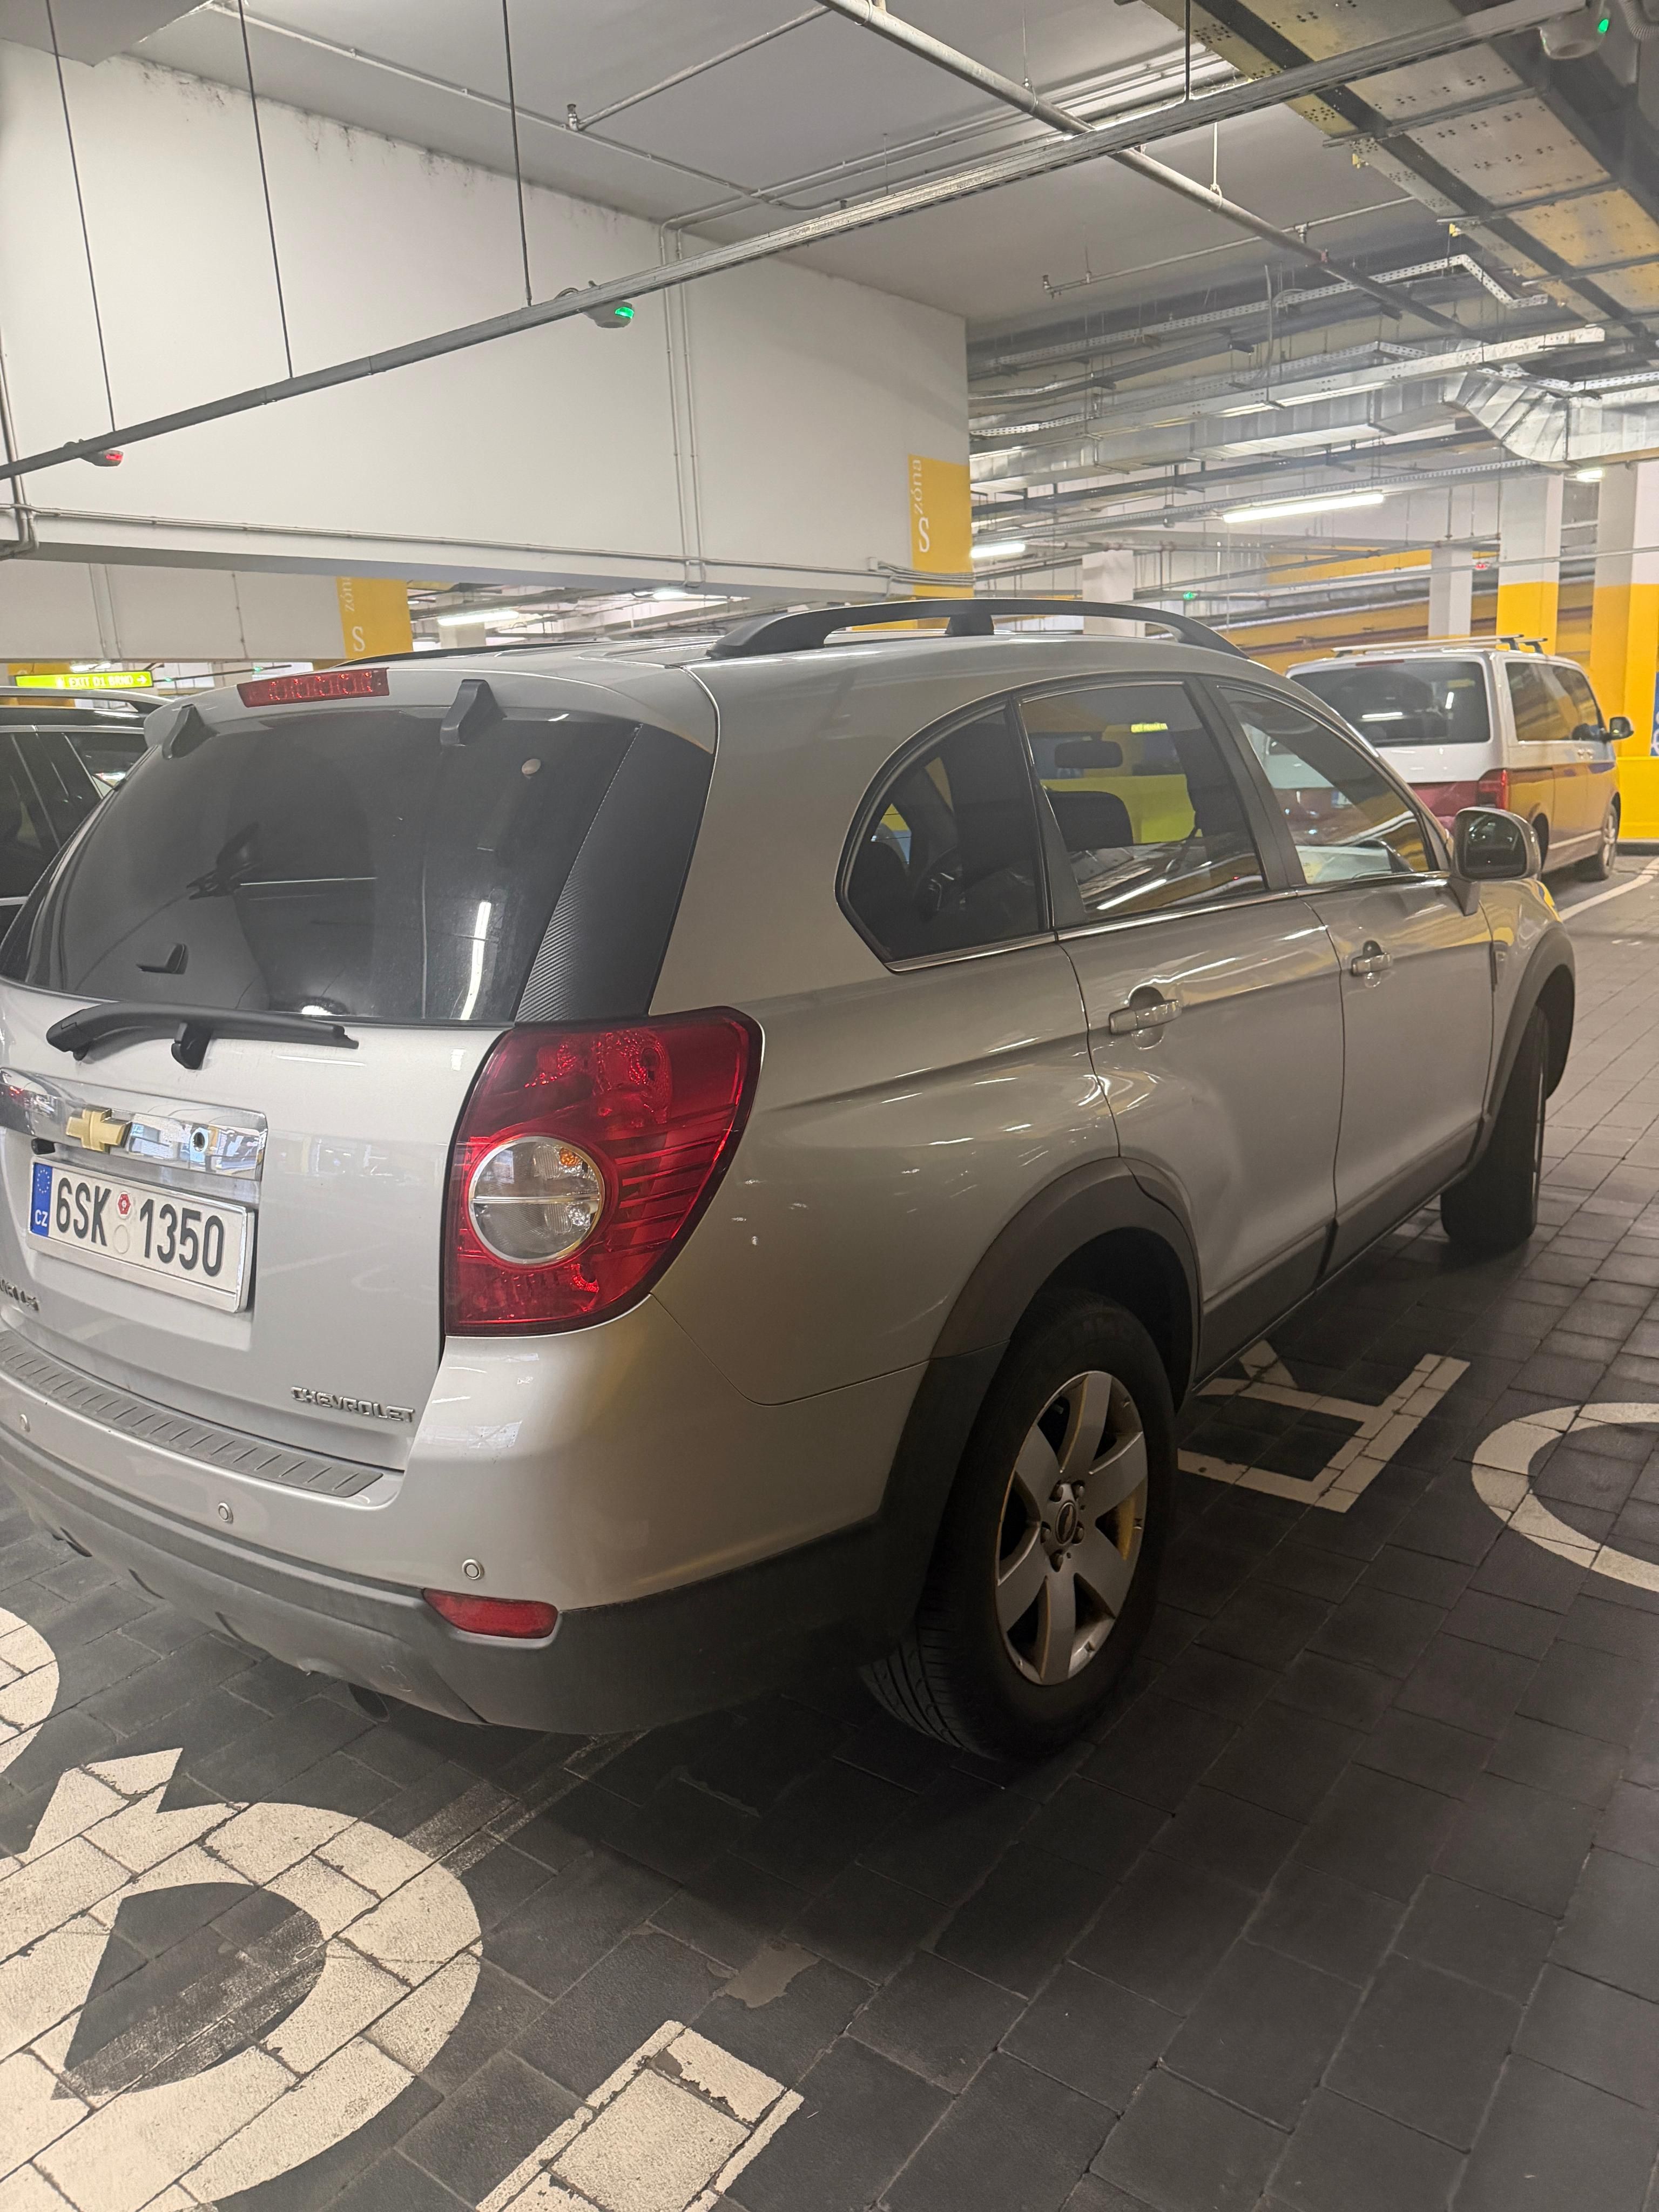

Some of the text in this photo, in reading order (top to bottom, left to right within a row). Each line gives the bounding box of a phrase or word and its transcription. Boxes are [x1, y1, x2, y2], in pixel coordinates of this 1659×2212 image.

[911, 460, 923, 515] zóna
[919, 517, 930, 552] S
[352, 626, 366, 652] S
[69, 675, 134, 687] EXIT D1 BRNO
[35, 1209, 48, 1229] CZ
[56, 1177, 225, 1278] 6SK 1350
[290, 1386, 415, 1423] CHEVROLET
